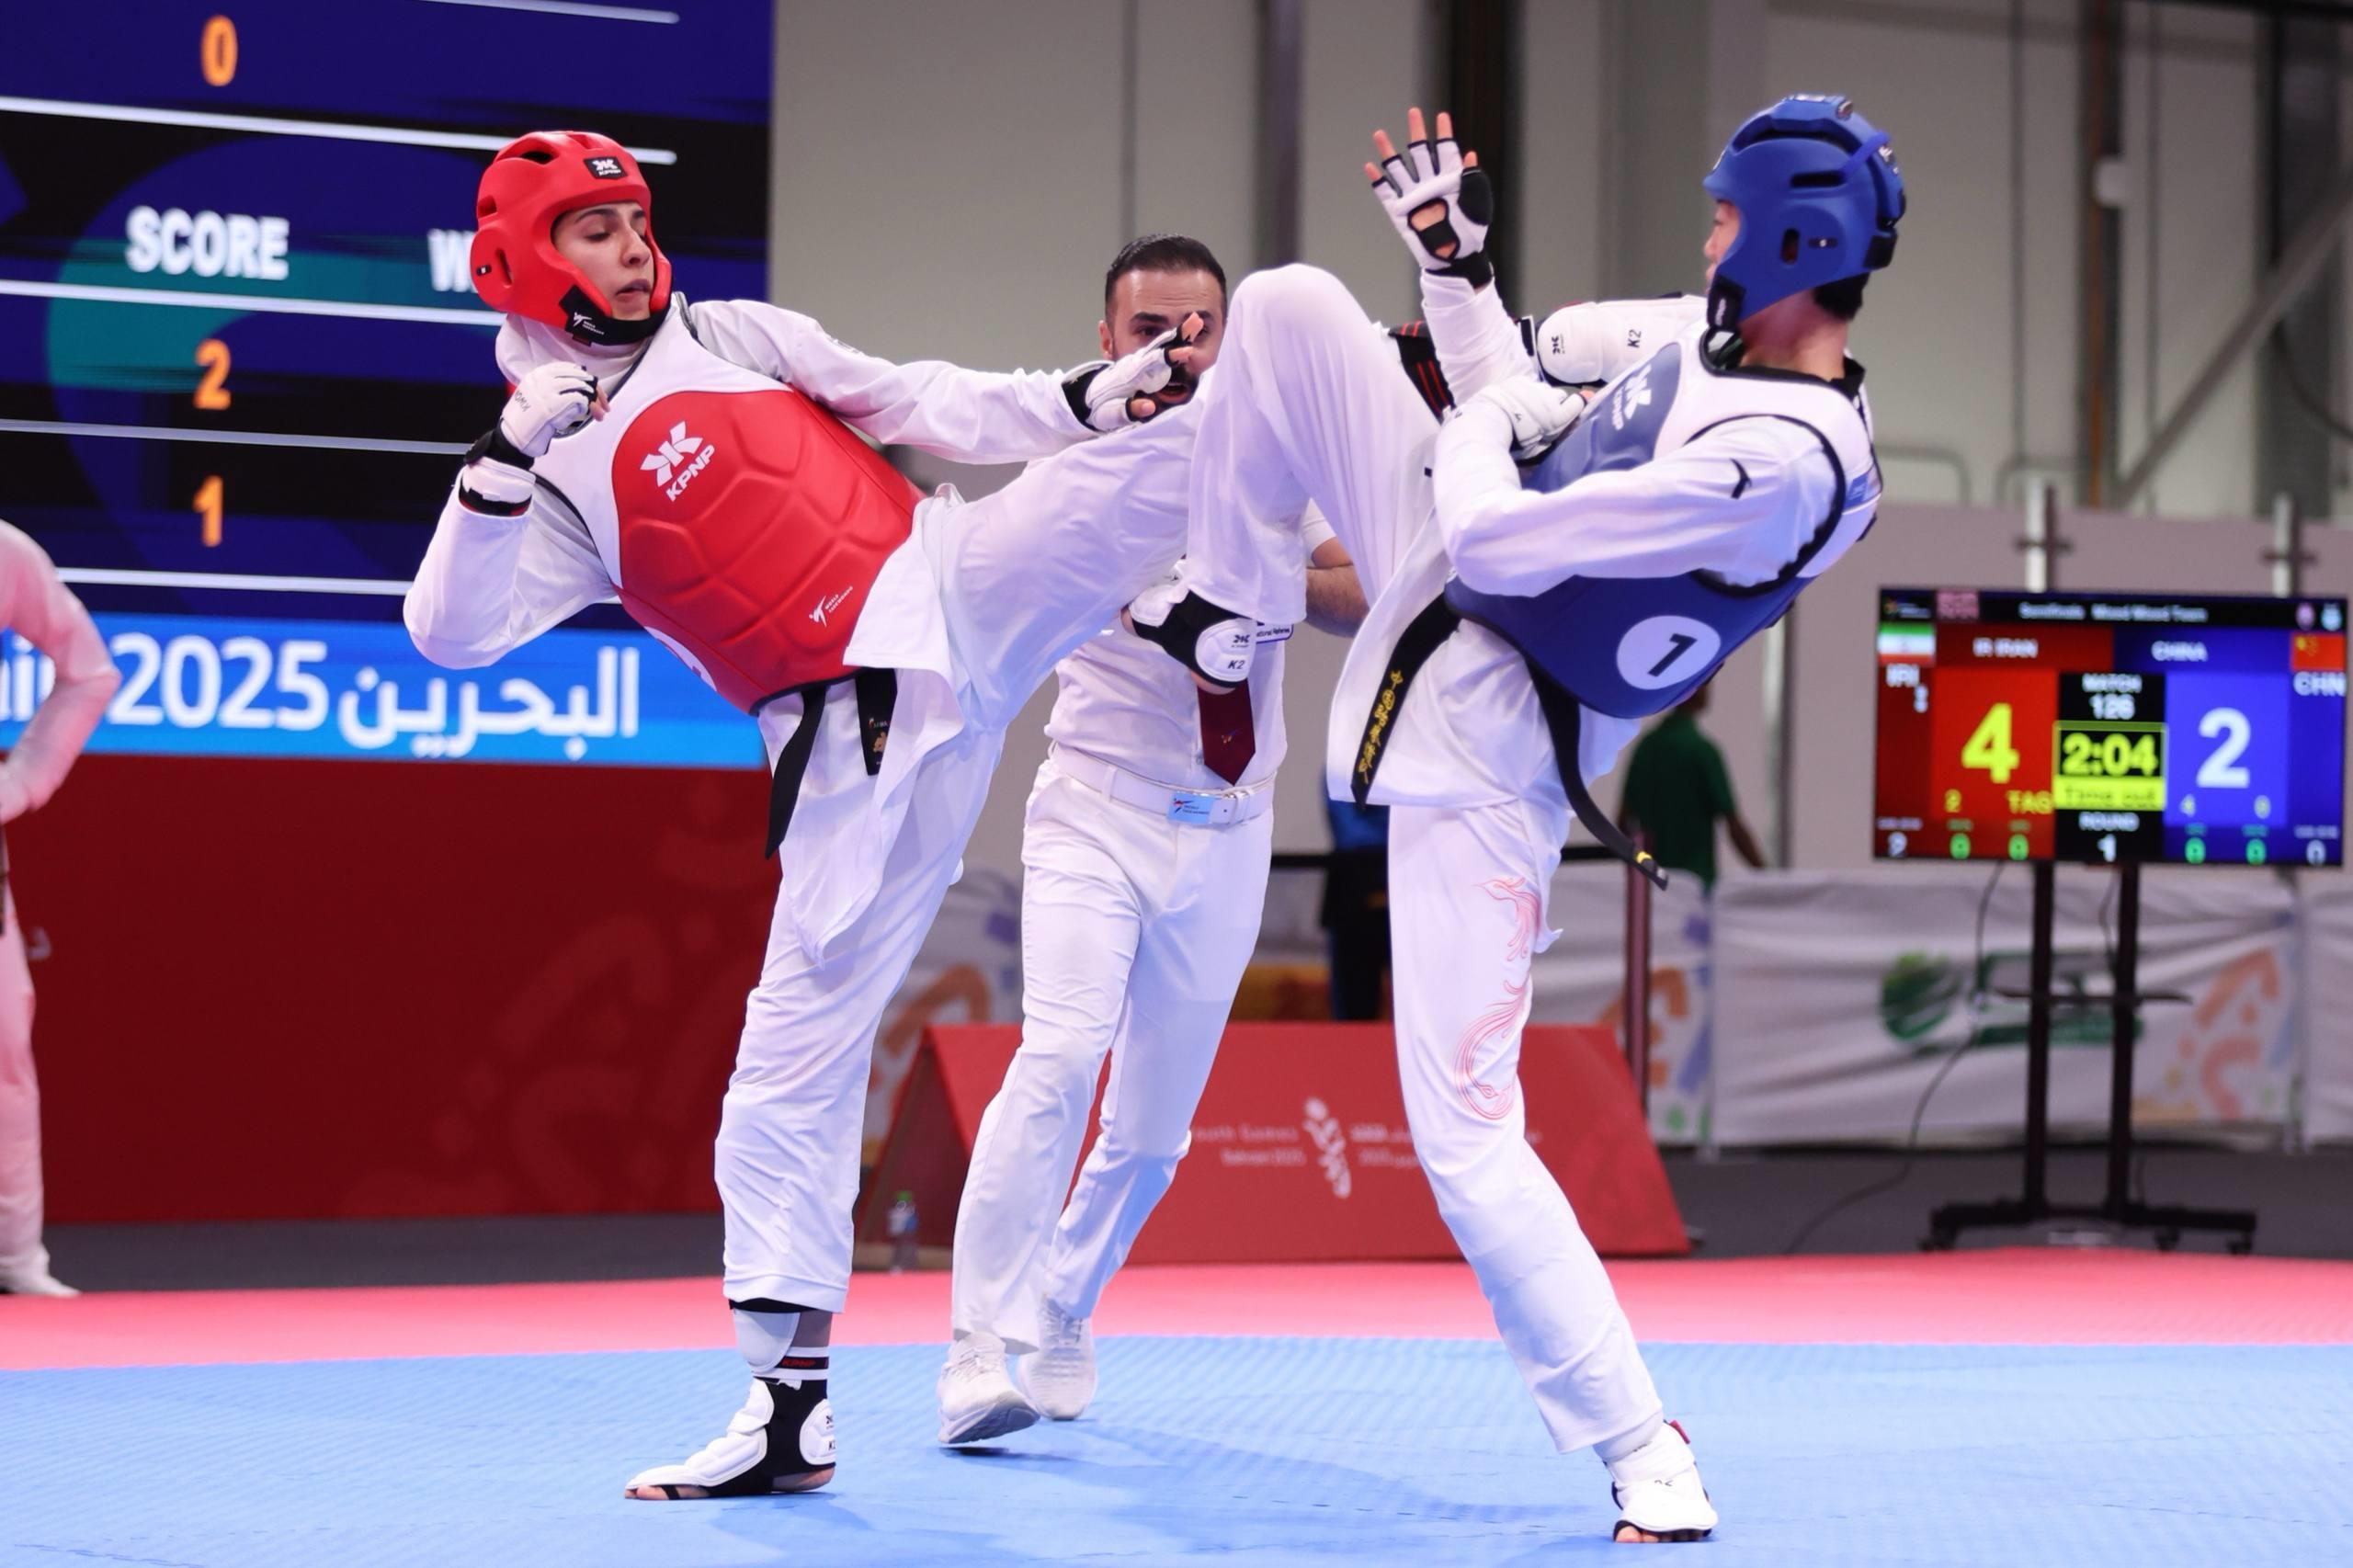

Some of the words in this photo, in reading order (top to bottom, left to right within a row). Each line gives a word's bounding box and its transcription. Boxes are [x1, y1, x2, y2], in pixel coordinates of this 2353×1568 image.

[200, 16, 238, 85] 0
[125, 205, 290, 281] SCORE
[1627, 329, 1642, 348] K2
[194, 340, 232, 410] 2
[666, 444, 715, 502] KPNP
[193, 475, 224, 547] 1
[1227, 660, 1245, 670] K2
[1648, 632, 1698, 677] 1
[2152, 641, 2208, 662] CHINA
[108, 632, 328, 732] 2025
[338, 645, 639, 759] البحرين
[2083, 674, 2143, 693] MATCH
[2294, 672, 2347, 697] CHN
[1961, 703, 2019, 784] 4
[2063, 732, 2158, 777] 2:04
[2196, 707, 2251, 789] 2
[2079, 812, 2139, 831] ROUND
